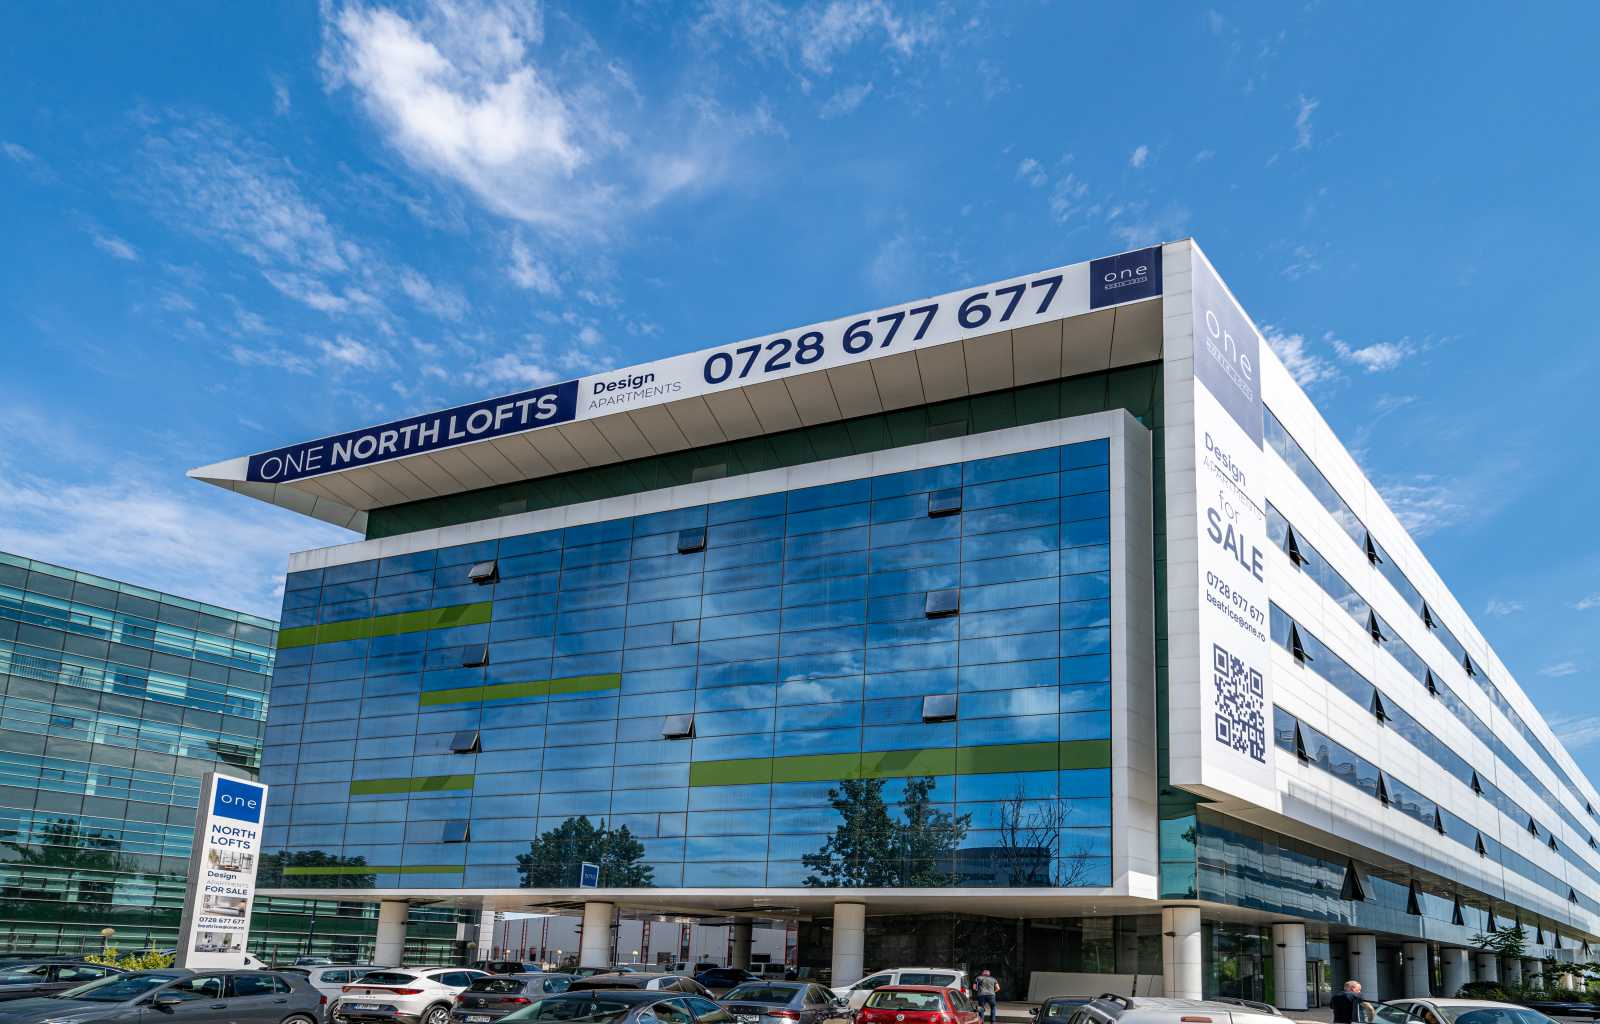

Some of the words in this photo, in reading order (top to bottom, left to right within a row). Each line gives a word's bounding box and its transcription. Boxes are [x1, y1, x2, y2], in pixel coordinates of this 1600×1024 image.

[1104, 265, 1147, 282] one
[703, 331, 825, 385] 0728
[842, 303, 939, 355] 677
[957, 275, 1064, 329] 677
[1206, 310, 1252, 381] one
[588, 381, 682, 411] APARTMENTS
[593, 371, 655, 395] Design
[260, 445, 324, 481] ONE
[330, 418, 440, 466] NORTH
[447, 393, 558, 441] LOFTS
[1204, 431, 1246, 487] Design
[1218, 489, 1240, 525] for
[1206, 506, 1264, 584] SALE
[1206, 570, 1231, 600] 0728
[1232, 591, 1248, 612] 677
[1250, 605, 1265, 625] 677
[1206, 588, 1266, 642] beatrice@one.ro
[221, 794, 257, 809] one
[210, 835, 251, 850] LOFTS
[212, 824, 256, 840] NORTH
[205, 885, 224, 894] FOR
[225, 887, 248, 896] SALE
[207, 870, 237, 881] Design
